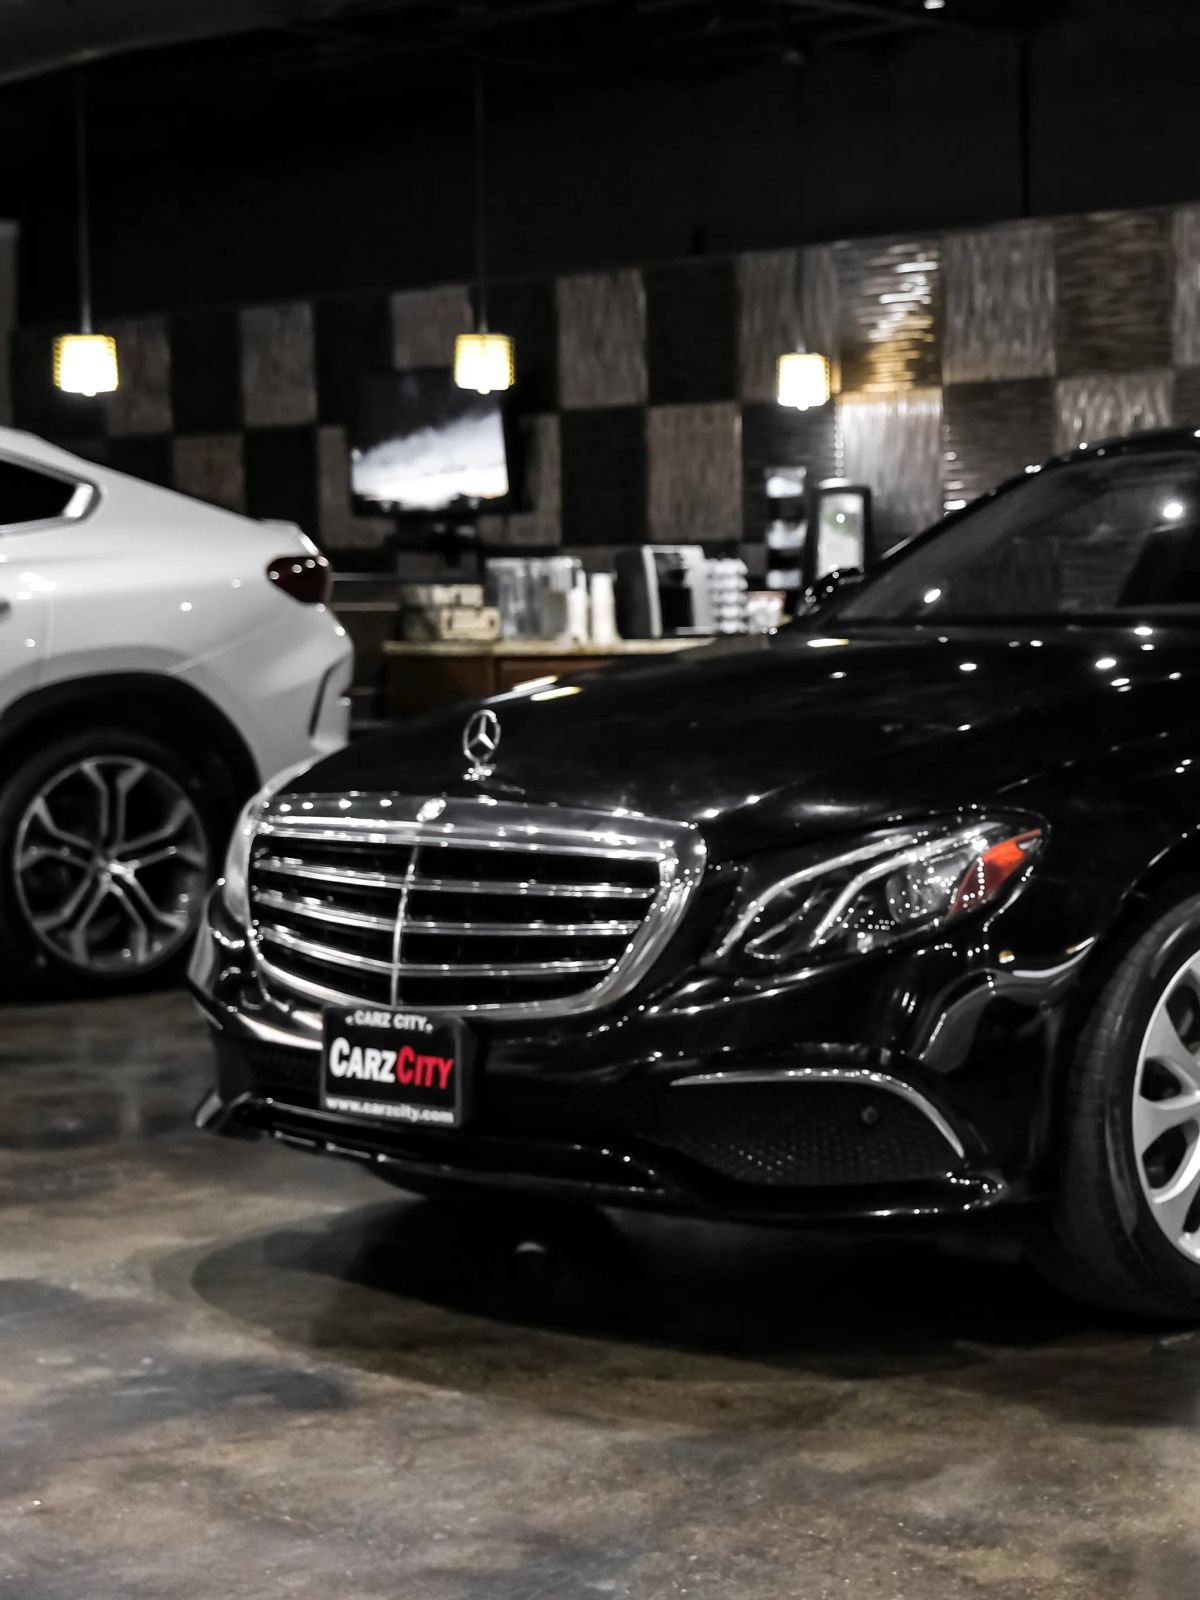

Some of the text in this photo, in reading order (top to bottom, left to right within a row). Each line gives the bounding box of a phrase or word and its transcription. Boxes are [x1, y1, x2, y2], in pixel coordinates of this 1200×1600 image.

[354, 1010, 427, 1031] CARZ CITY
[326, 1097, 454, 1124] www.carzcity.com
